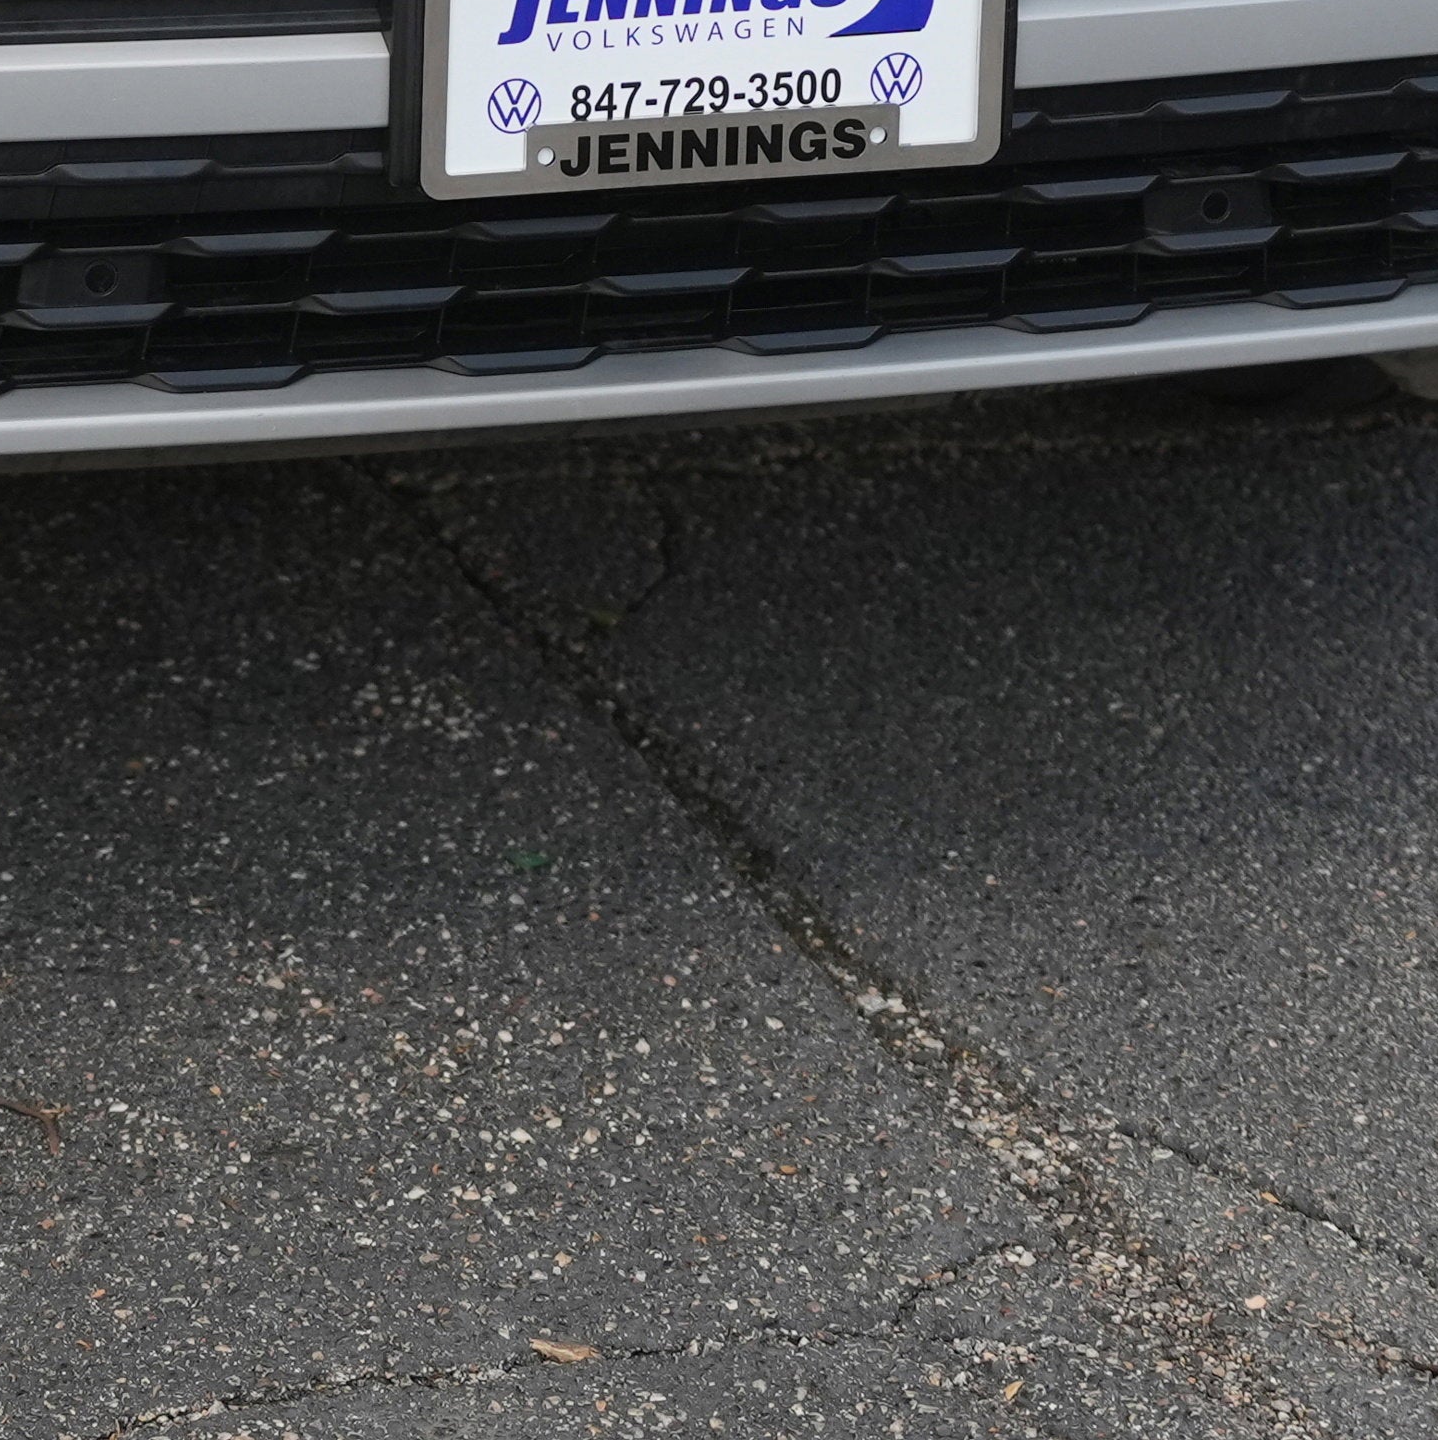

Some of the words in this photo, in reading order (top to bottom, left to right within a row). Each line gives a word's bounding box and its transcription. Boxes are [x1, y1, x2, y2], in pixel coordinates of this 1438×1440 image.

[546, 15, 806, 53] VOLKSWAGEN
[570, 67, 842, 122] 847-729-3500
[560, 118, 867, 177] JENNINGS
